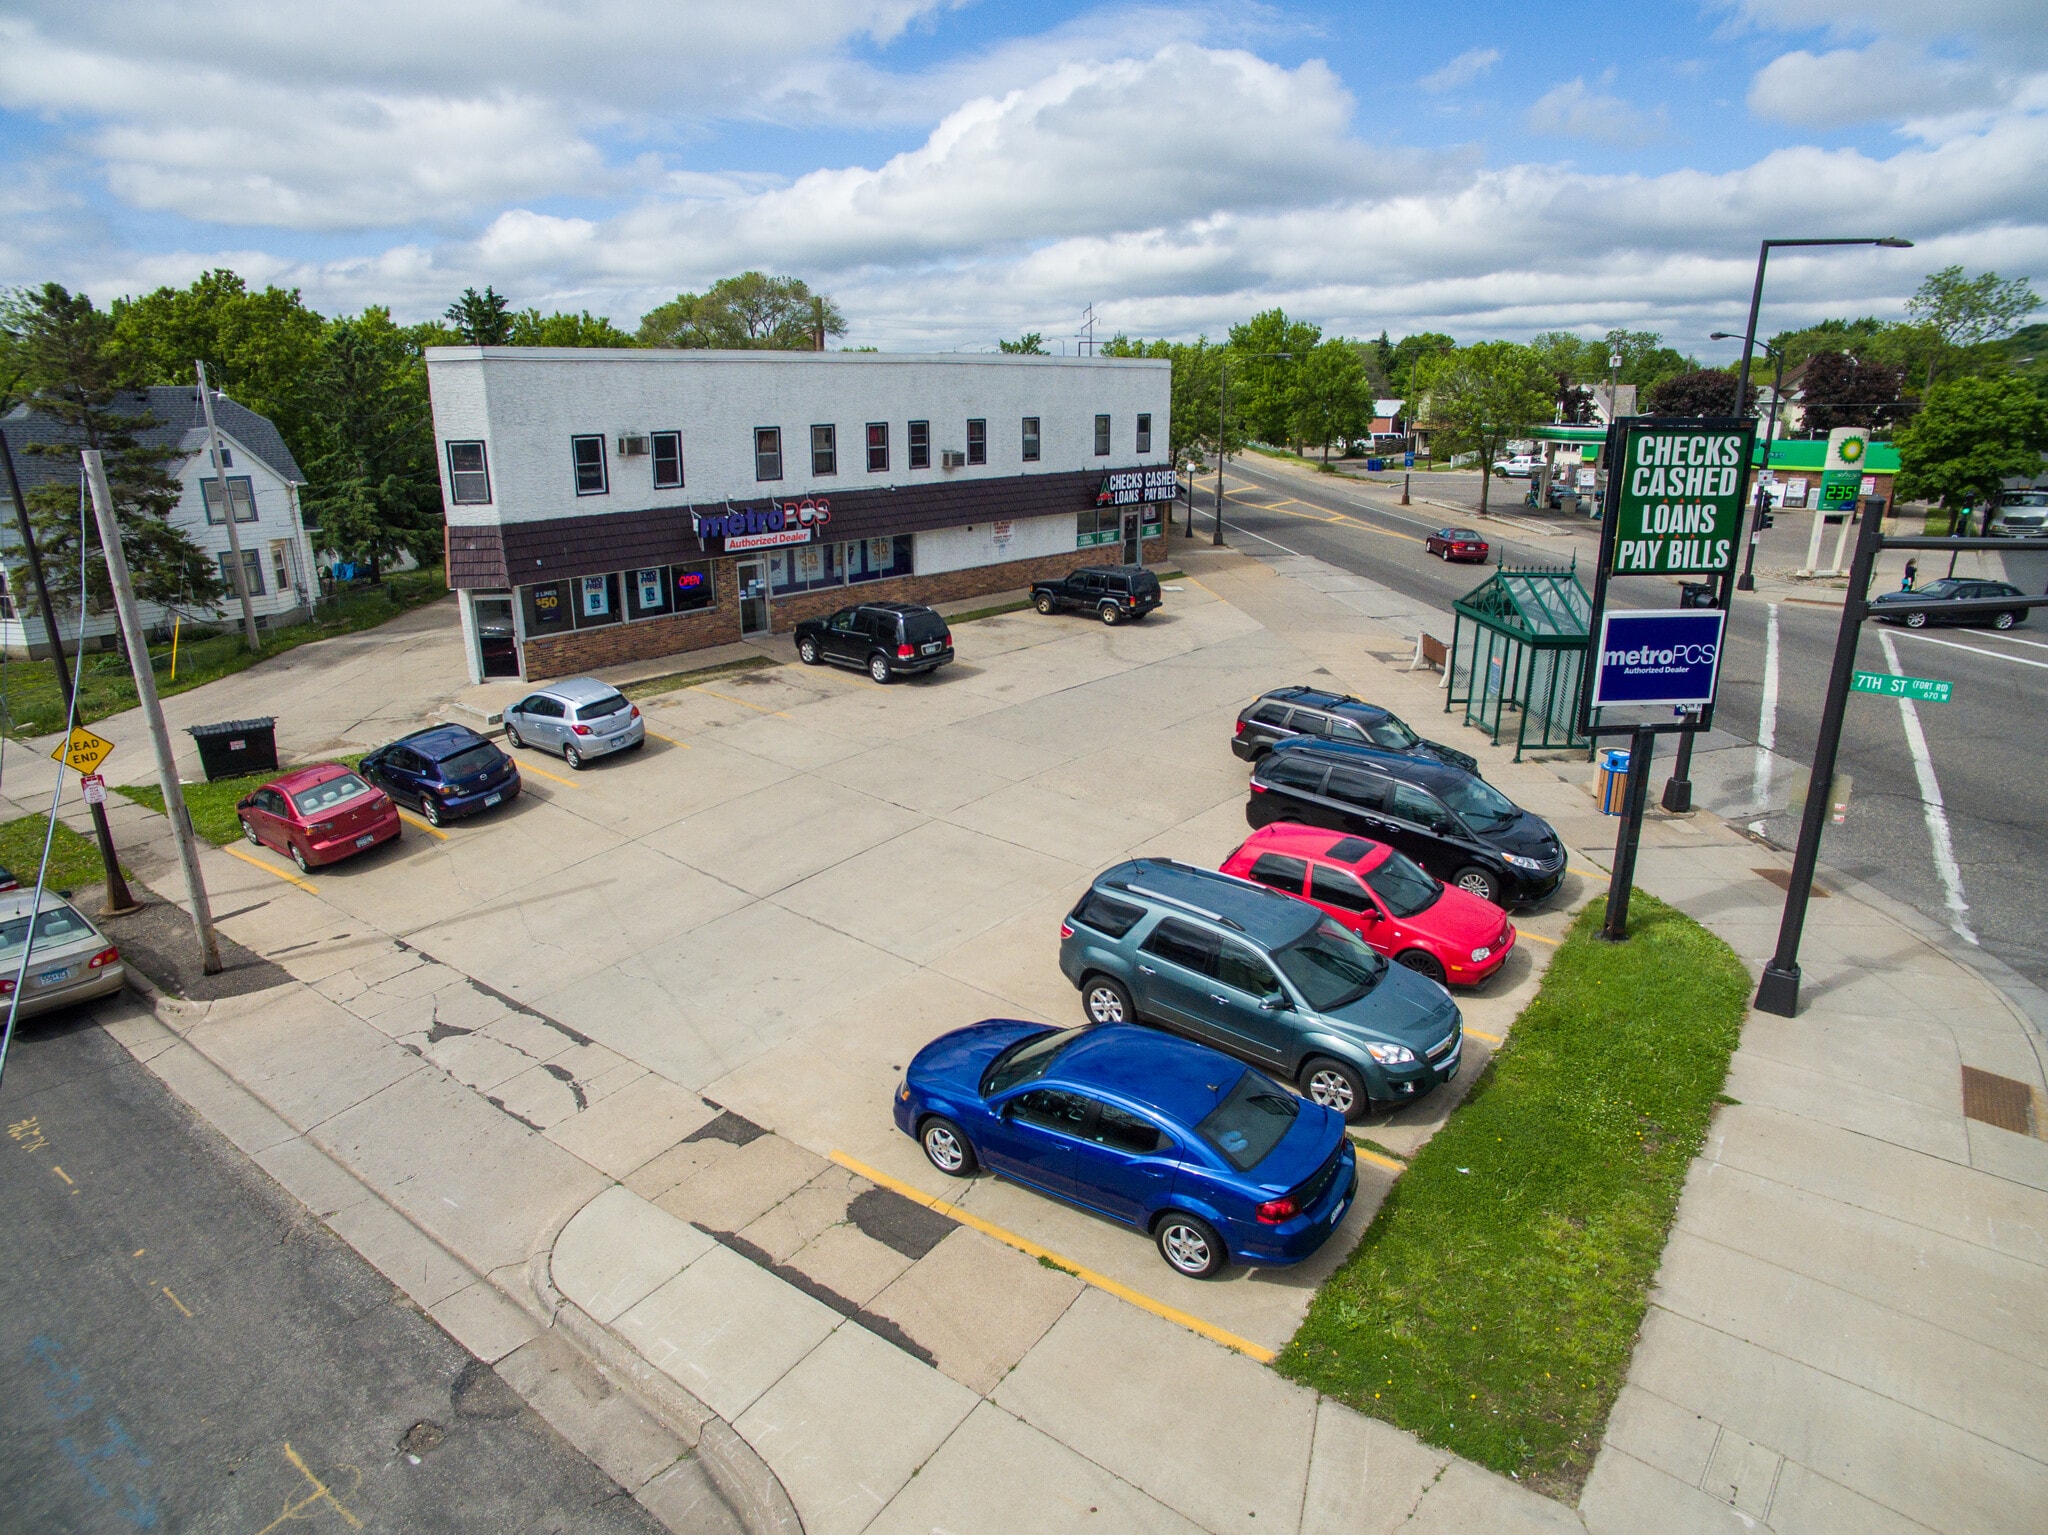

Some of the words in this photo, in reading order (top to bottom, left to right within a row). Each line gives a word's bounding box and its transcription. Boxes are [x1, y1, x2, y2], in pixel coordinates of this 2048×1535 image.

[1637, 436, 1741, 466] CHECKS
[1110, 473, 1142, 490] CHECKS
[1145, 471, 1176, 487] CASHED
[1632, 467, 1738, 497] CASHED
[1115, 489, 1139, 504] LOANS
[1144, 487, 1156, 501] PAY
[1157, 486, 1176, 499] BILLS
[700, 498, 832, 538] metroPCS
[1641, 504, 1717, 534] LOANS
[729, 534, 778, 549] Authorized
[779, 532, 808, 543] Dealer
[1618, 540, 1663, 569] PAY
[1667, 539, 1731, 569] BILLS
[679, 575, 700, 587] OPEN
[536, 596, 558, 609] $50
[1603, 644, 1716, 666] metroPCS
[1857, 675, 1883, 690] 7TH
[1890, 679, 1908, 693] ST
[1912, 680, 1933, 690] (FORT
[1935, 684, 1949, 692] RD)
[1923, 691, 1939, 699] 670
[73, 752, 98, 764] END
